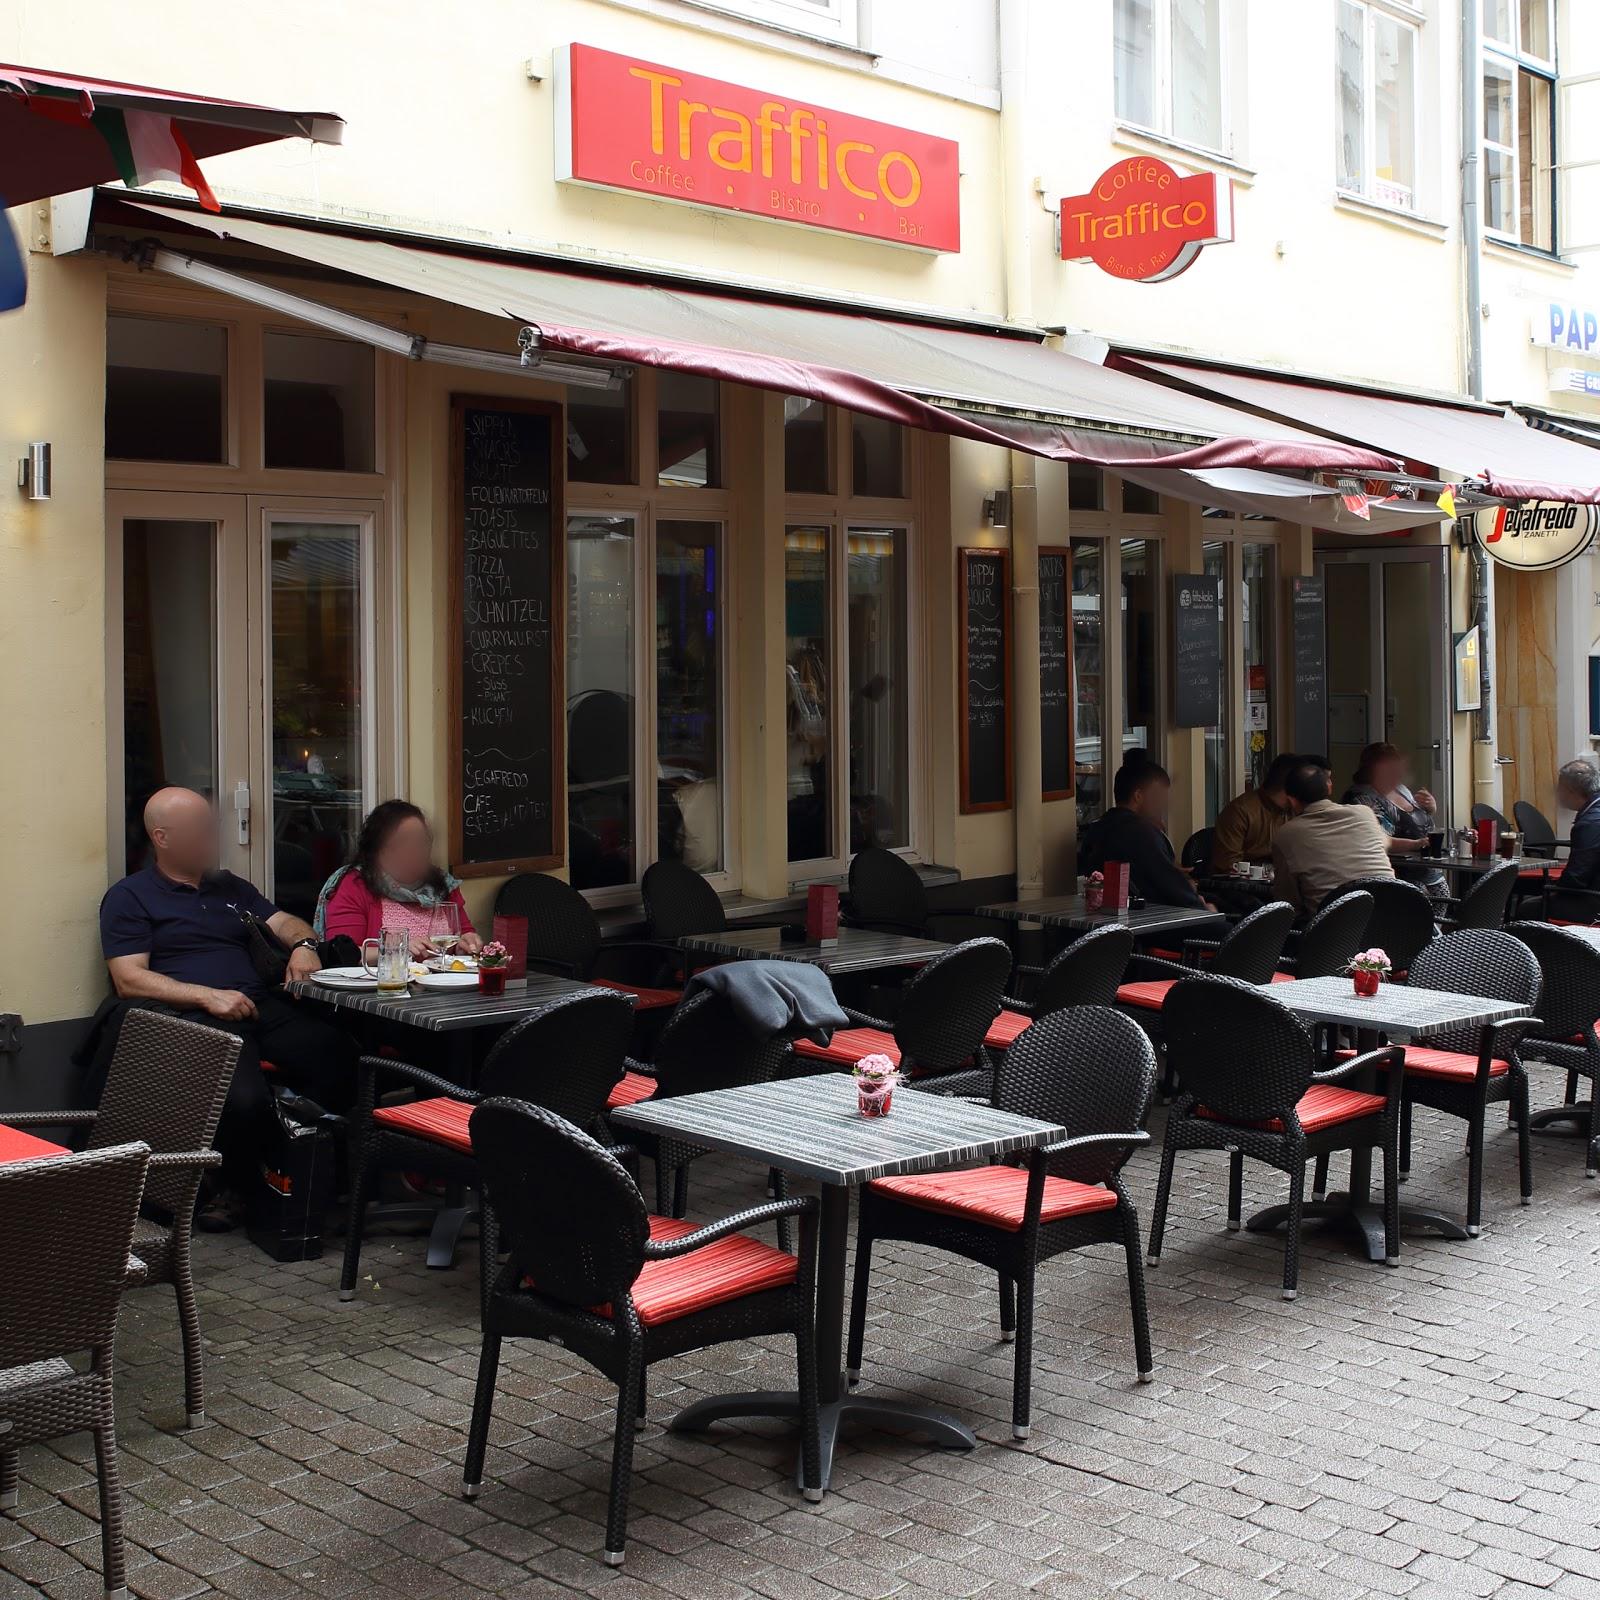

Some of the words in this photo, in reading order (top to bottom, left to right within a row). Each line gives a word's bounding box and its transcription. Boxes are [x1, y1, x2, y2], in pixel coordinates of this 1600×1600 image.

[629, 67, 922, 208] Traffico
[1097, 159, 1171, 202] Coffee
[630, 160, 695, 191] Coffee
[770, 189, 821, 217] Bistro
[899, 217, 925, 238] Bar
[1071, 201, 1207, 243] Traffico
[1105, 255, 1134, 275] Bistro
[1150, 249, 1168, 268] Bar
[470, 507, 519, 527] TOASTS
[469, 529, 538, 551] BAGUETTES
[1523, 530, 1559, 539] ZANETTI
[468, 554, 505, 575] PIZZA
[466, 575, 512, 599] PASTA
[468, 598, 549, 625] SCHNITZEL
[470, 630, 549, 650] CURRYWURST
[464, 762, 529, 789] SEGAFREDO
